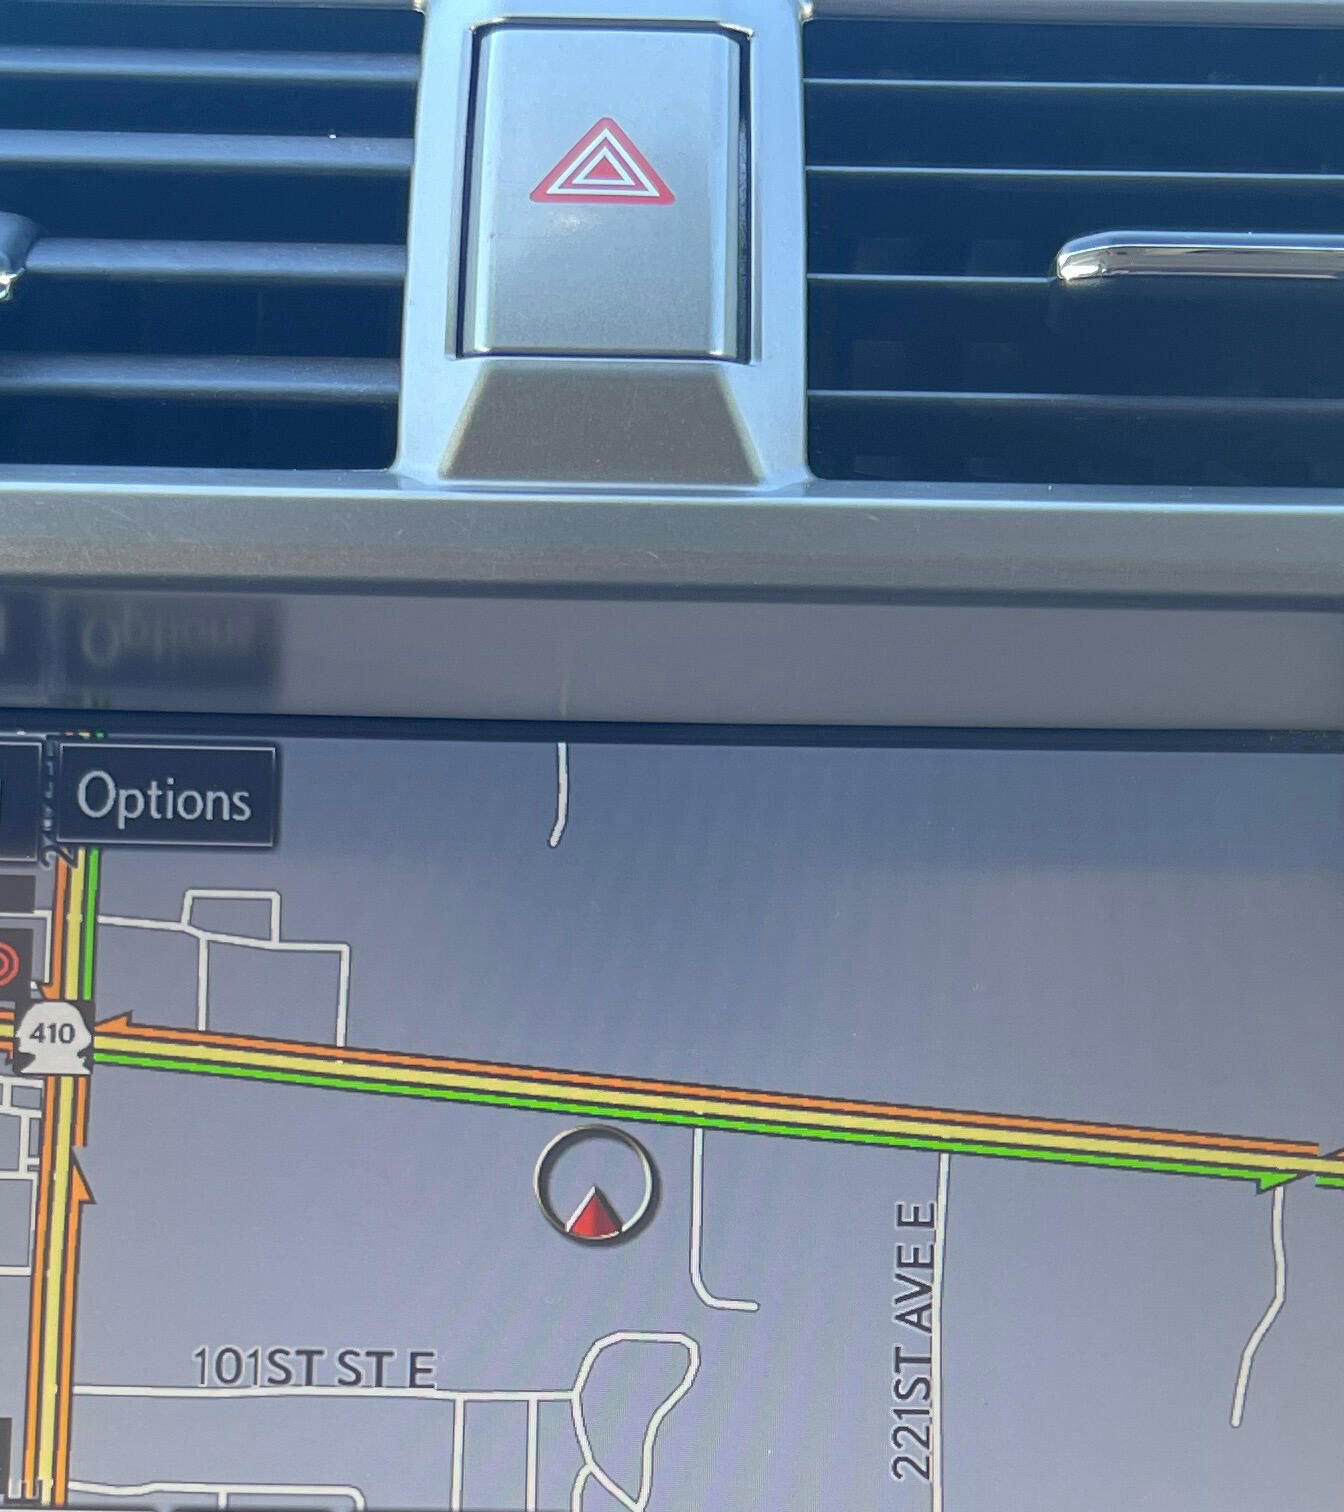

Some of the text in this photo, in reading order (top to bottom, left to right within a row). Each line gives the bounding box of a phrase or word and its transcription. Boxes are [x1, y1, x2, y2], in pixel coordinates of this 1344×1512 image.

[77, 770, 251, 830] Options
[29, 1022, 76, 1045] 410
[891, 1202, 935, 1481] 221ST AVE E
[193, 1347, 435, 1389] 101ST ST E
